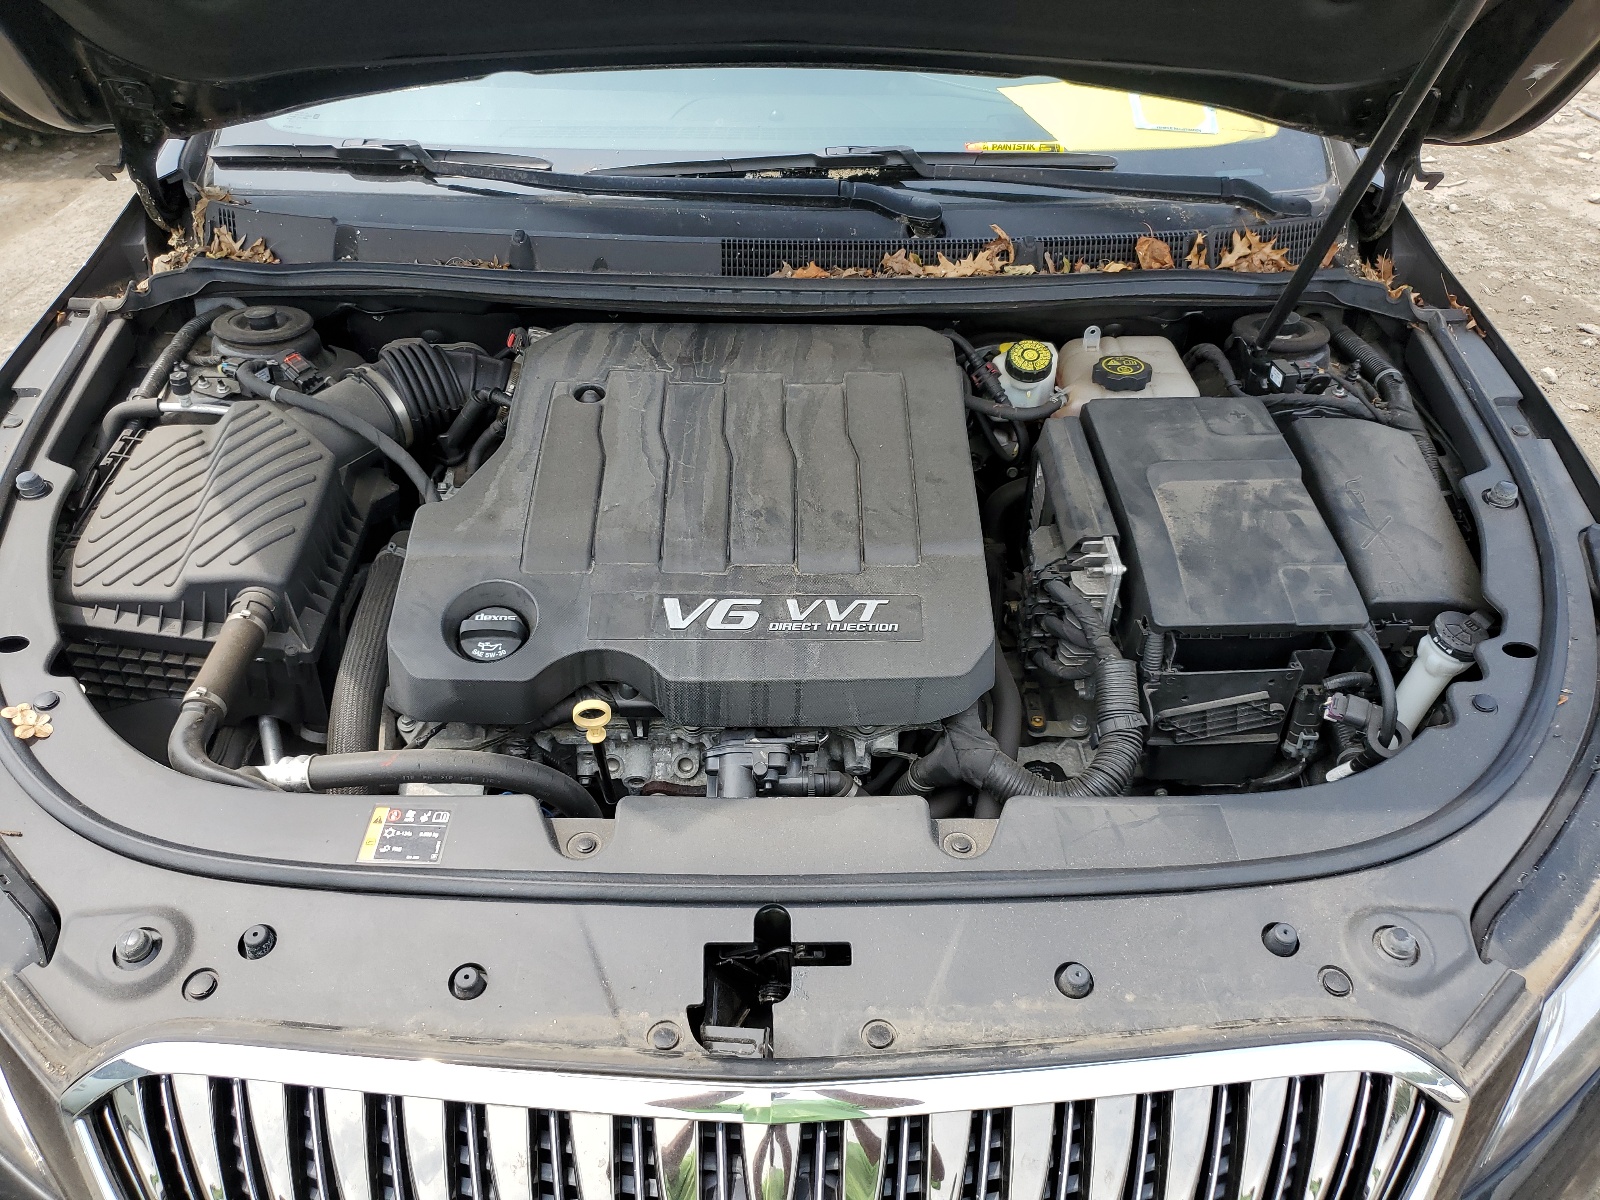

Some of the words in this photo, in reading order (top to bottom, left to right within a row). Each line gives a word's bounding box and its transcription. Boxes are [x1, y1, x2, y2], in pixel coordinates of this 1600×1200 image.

[991, 143, 1036, 151] PAINTSTIK
[663, 598, 763, 631] V6
[786, 599, 890, 622] VVT
[768, 622, 822, 632] DIRECT
[826, 623, 900, 633] INJECTION
[471, 648, 485, 658] SAE
[484, 649, 507, 658] 5W-30
